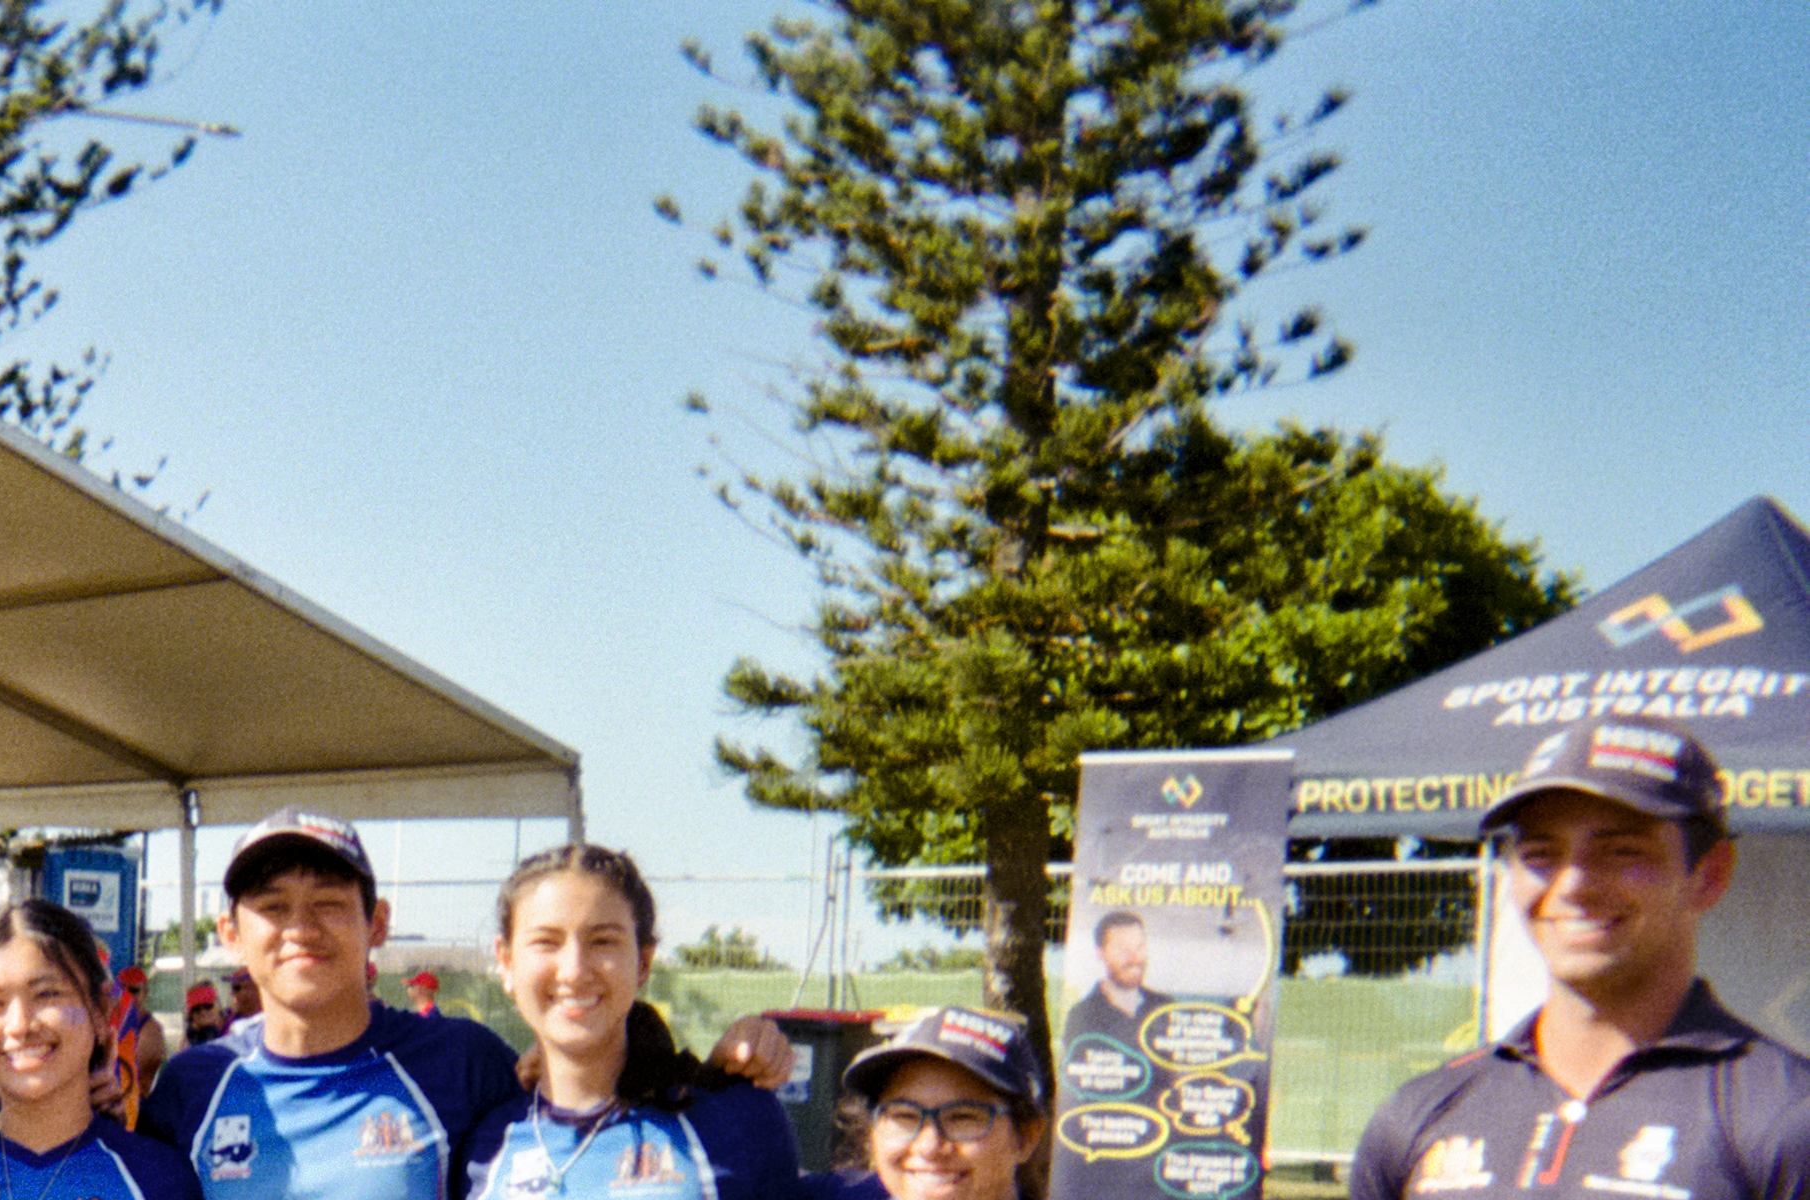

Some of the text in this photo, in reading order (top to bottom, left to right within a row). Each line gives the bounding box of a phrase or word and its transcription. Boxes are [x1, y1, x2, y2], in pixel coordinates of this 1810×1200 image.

[1443, 671, 1589, 708] SPORT
[1493, 695, 1752, 726] AUSTRALIA
[1120, 861, 1232, 884] COME AND
[1090, 884, 1133, 906] ASK
[1136, 884, 1165, 906] US
[944, 1009, 1014, 1045] NSW
